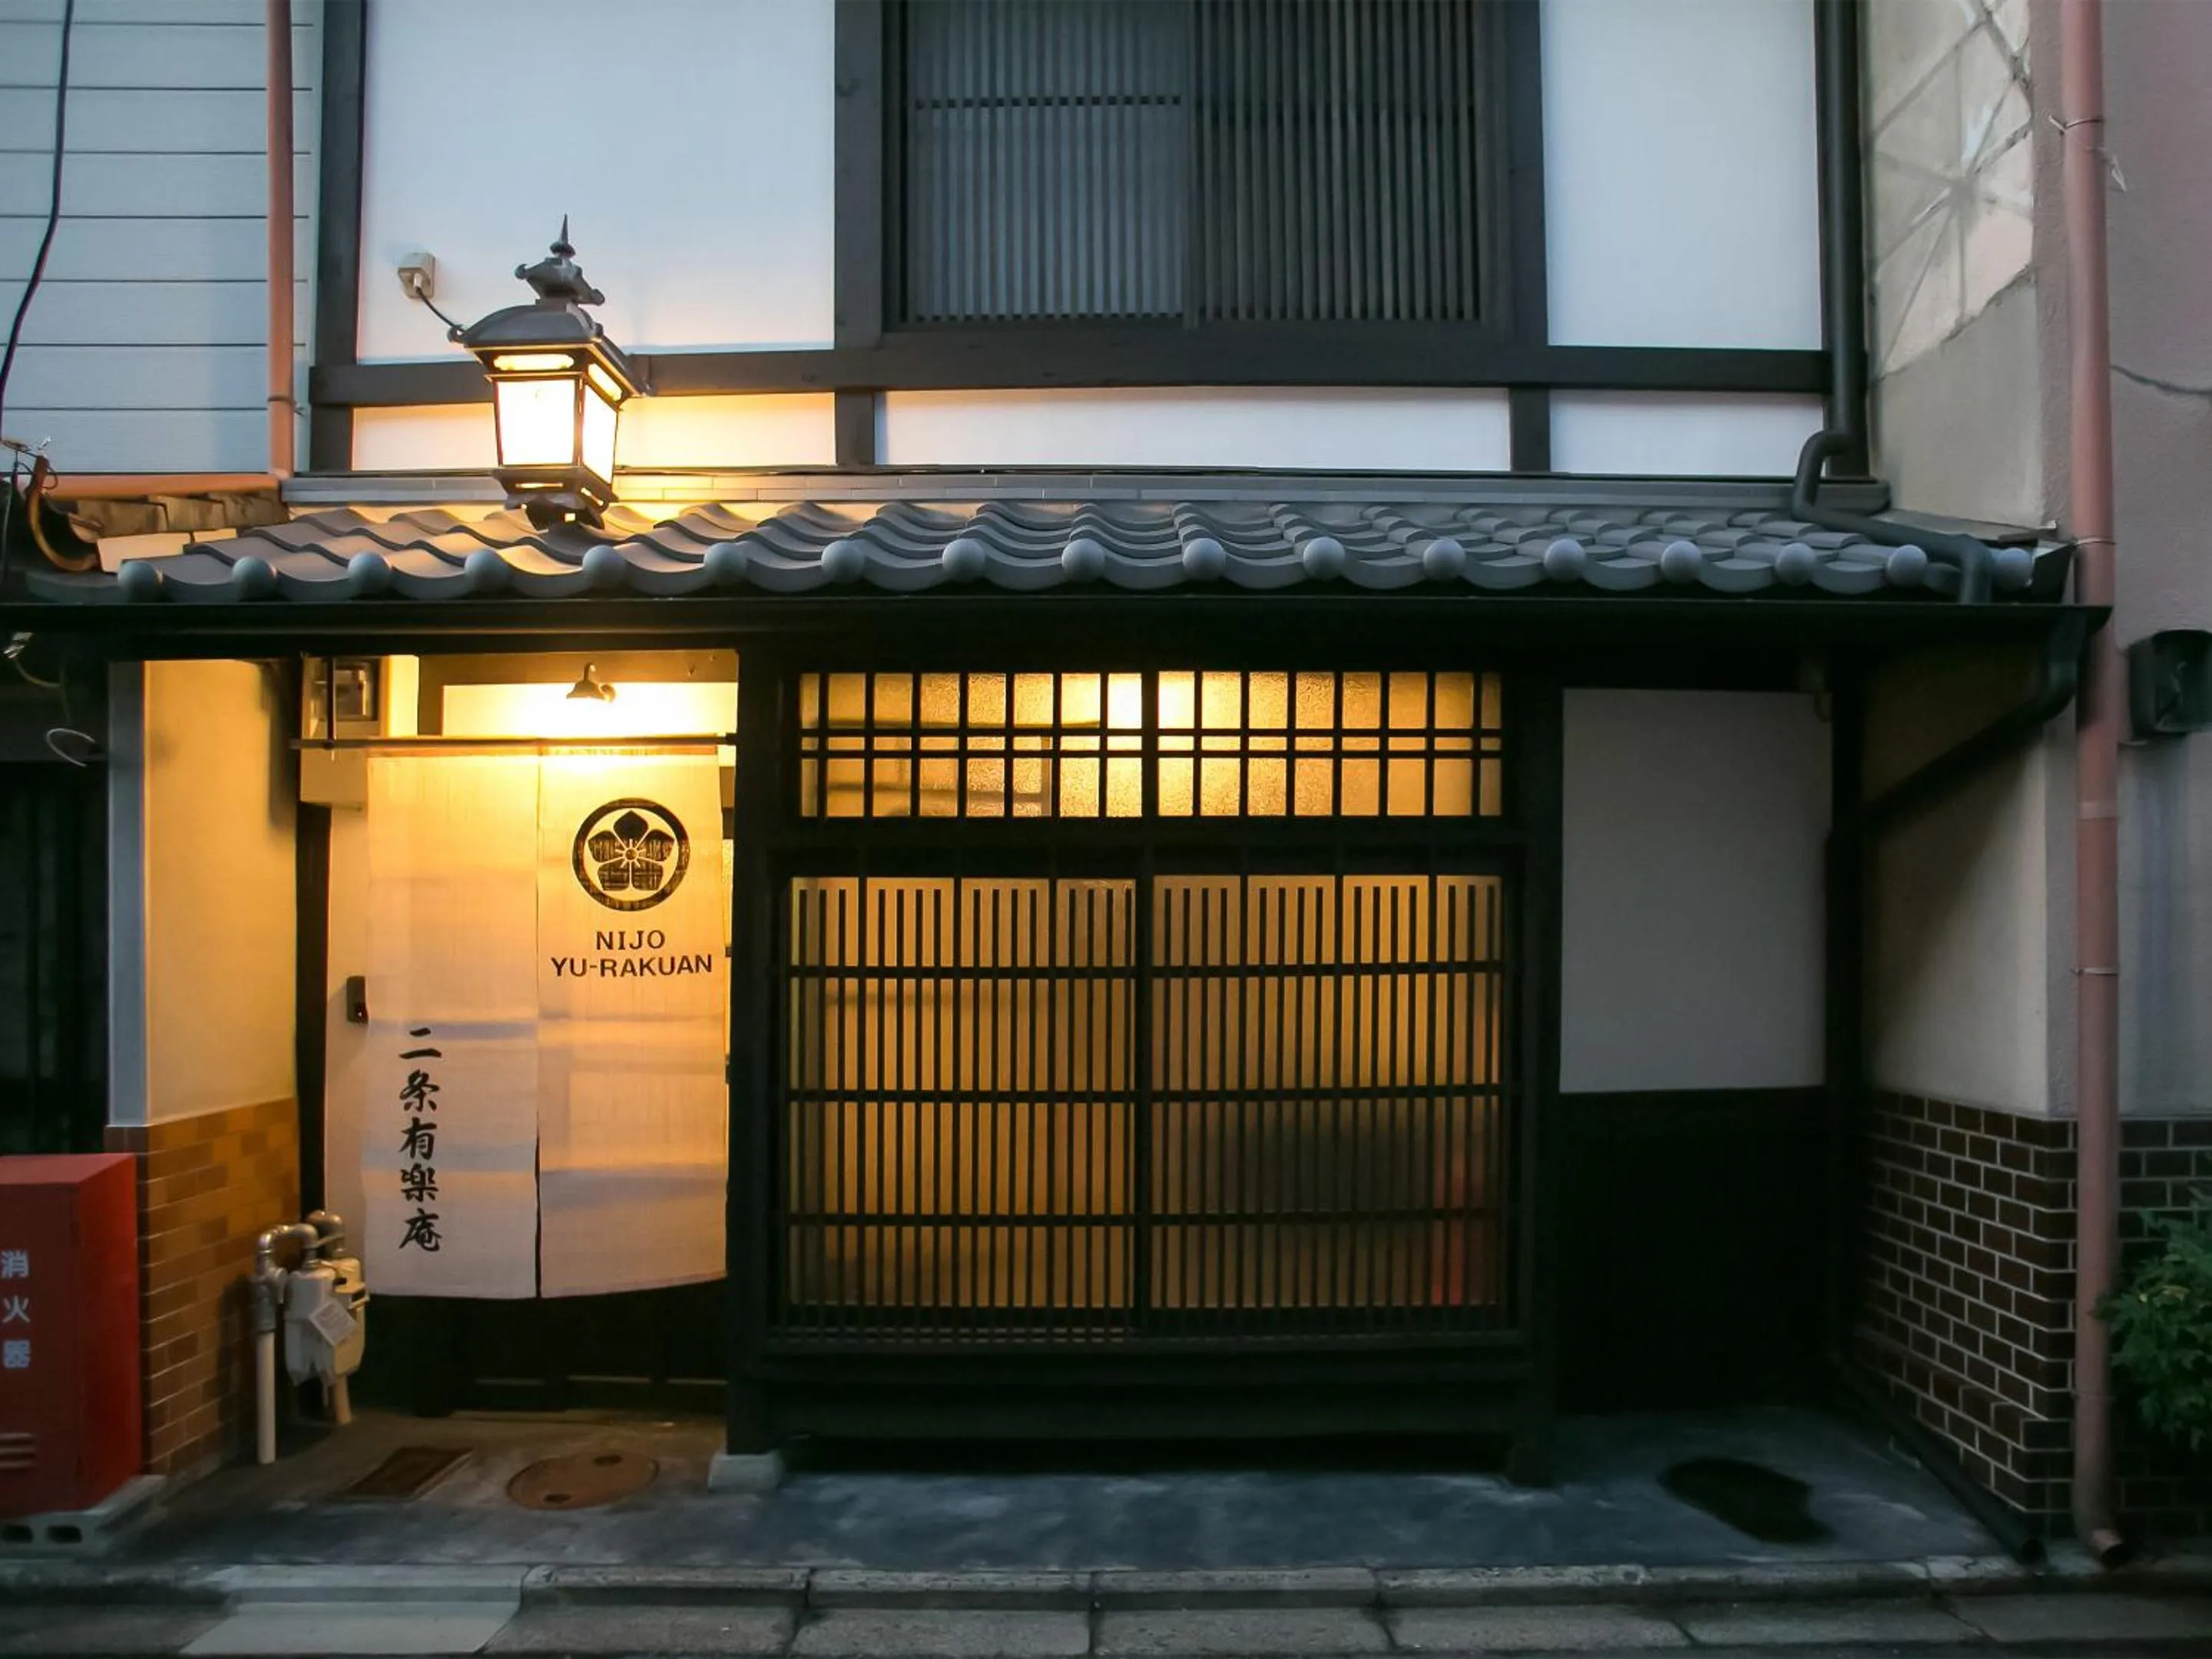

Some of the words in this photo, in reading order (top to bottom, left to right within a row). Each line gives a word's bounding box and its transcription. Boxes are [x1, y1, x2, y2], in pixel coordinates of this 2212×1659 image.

[596, 930, 666, 950] NIJO
[551, 955, 712, 977] YU-RAKUAN
[1, 1250, 31, 1369] 消火器
